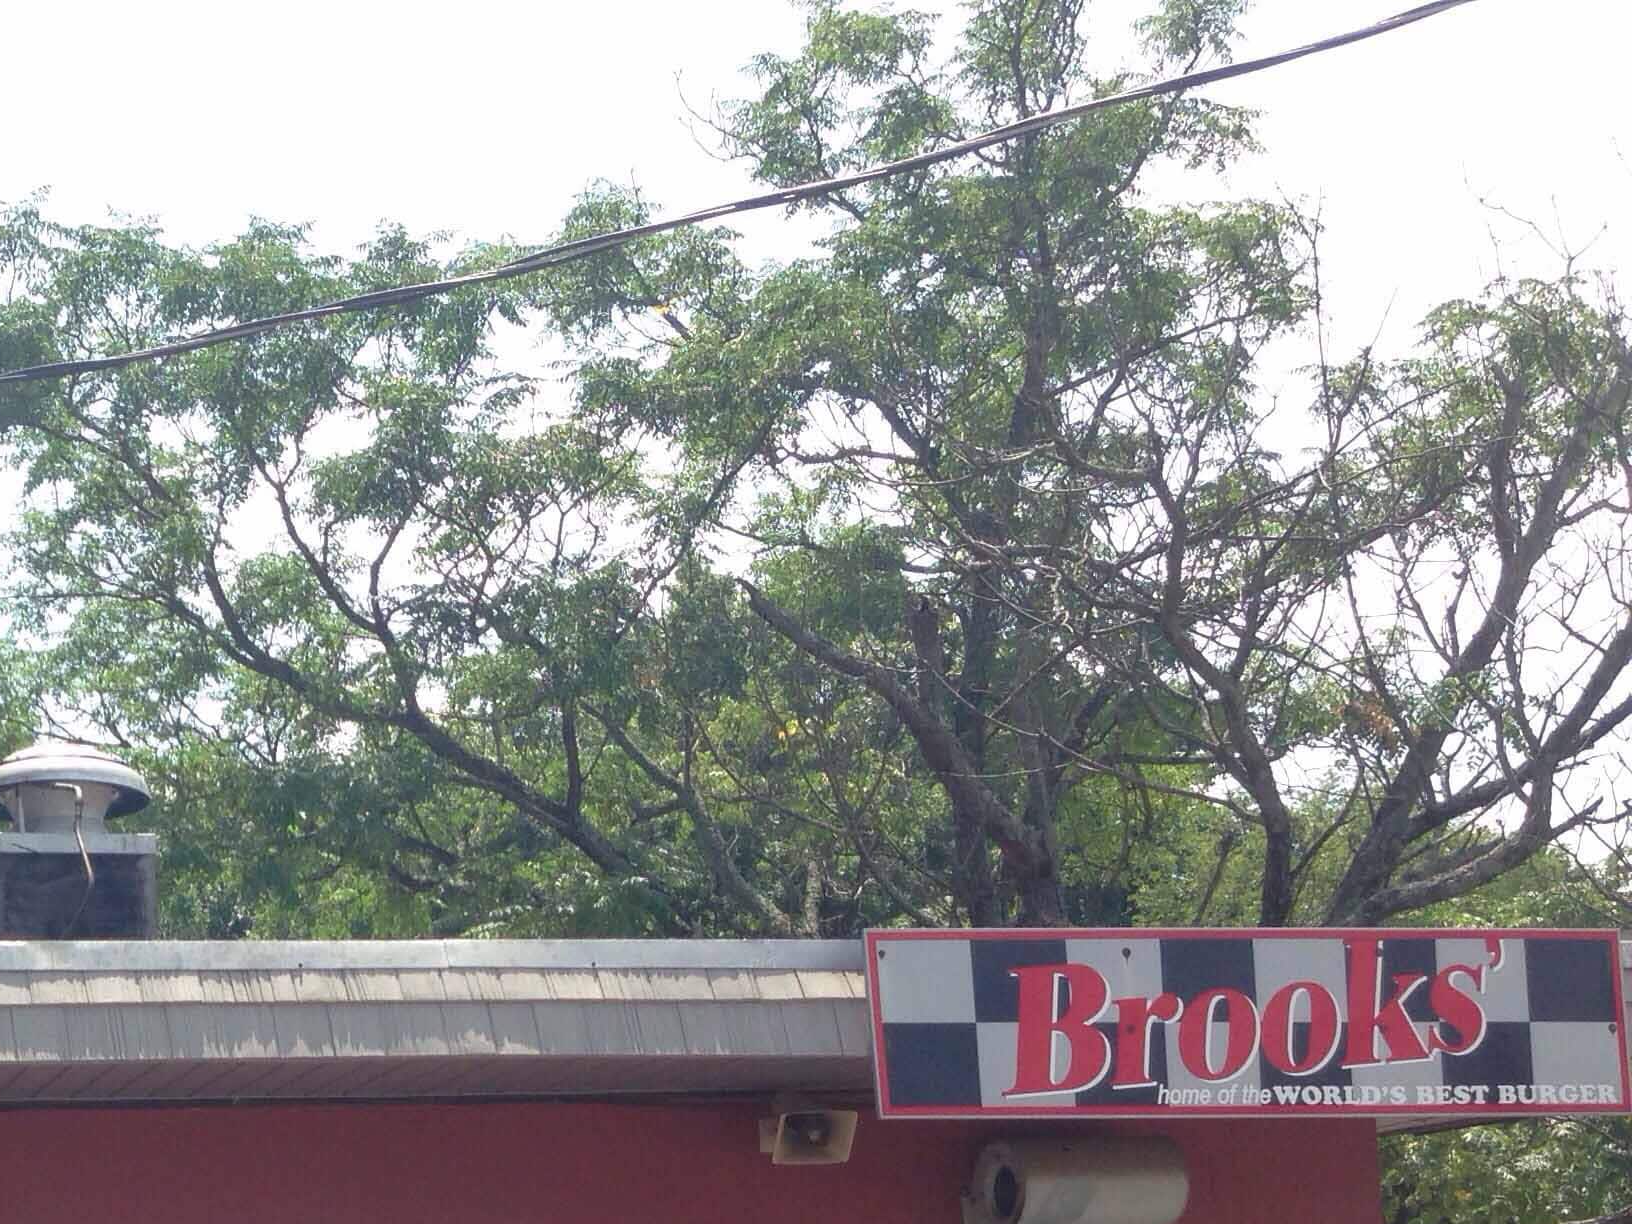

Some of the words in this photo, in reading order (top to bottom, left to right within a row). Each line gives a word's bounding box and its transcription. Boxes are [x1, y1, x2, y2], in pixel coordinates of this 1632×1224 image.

[1002, 939, 1504, 1099] Brooks'
[1157, 1083, 1212, 1105] home
[1217, 1084, 1240, 1105] of
[1241, 1084, 1272, 1105] the
[1273, 1084, 1407, 1106] WORLD'S
[1415, 1084, 1490, 1105] BEST
[1496, 1084, 1618, 1105] BURGER
